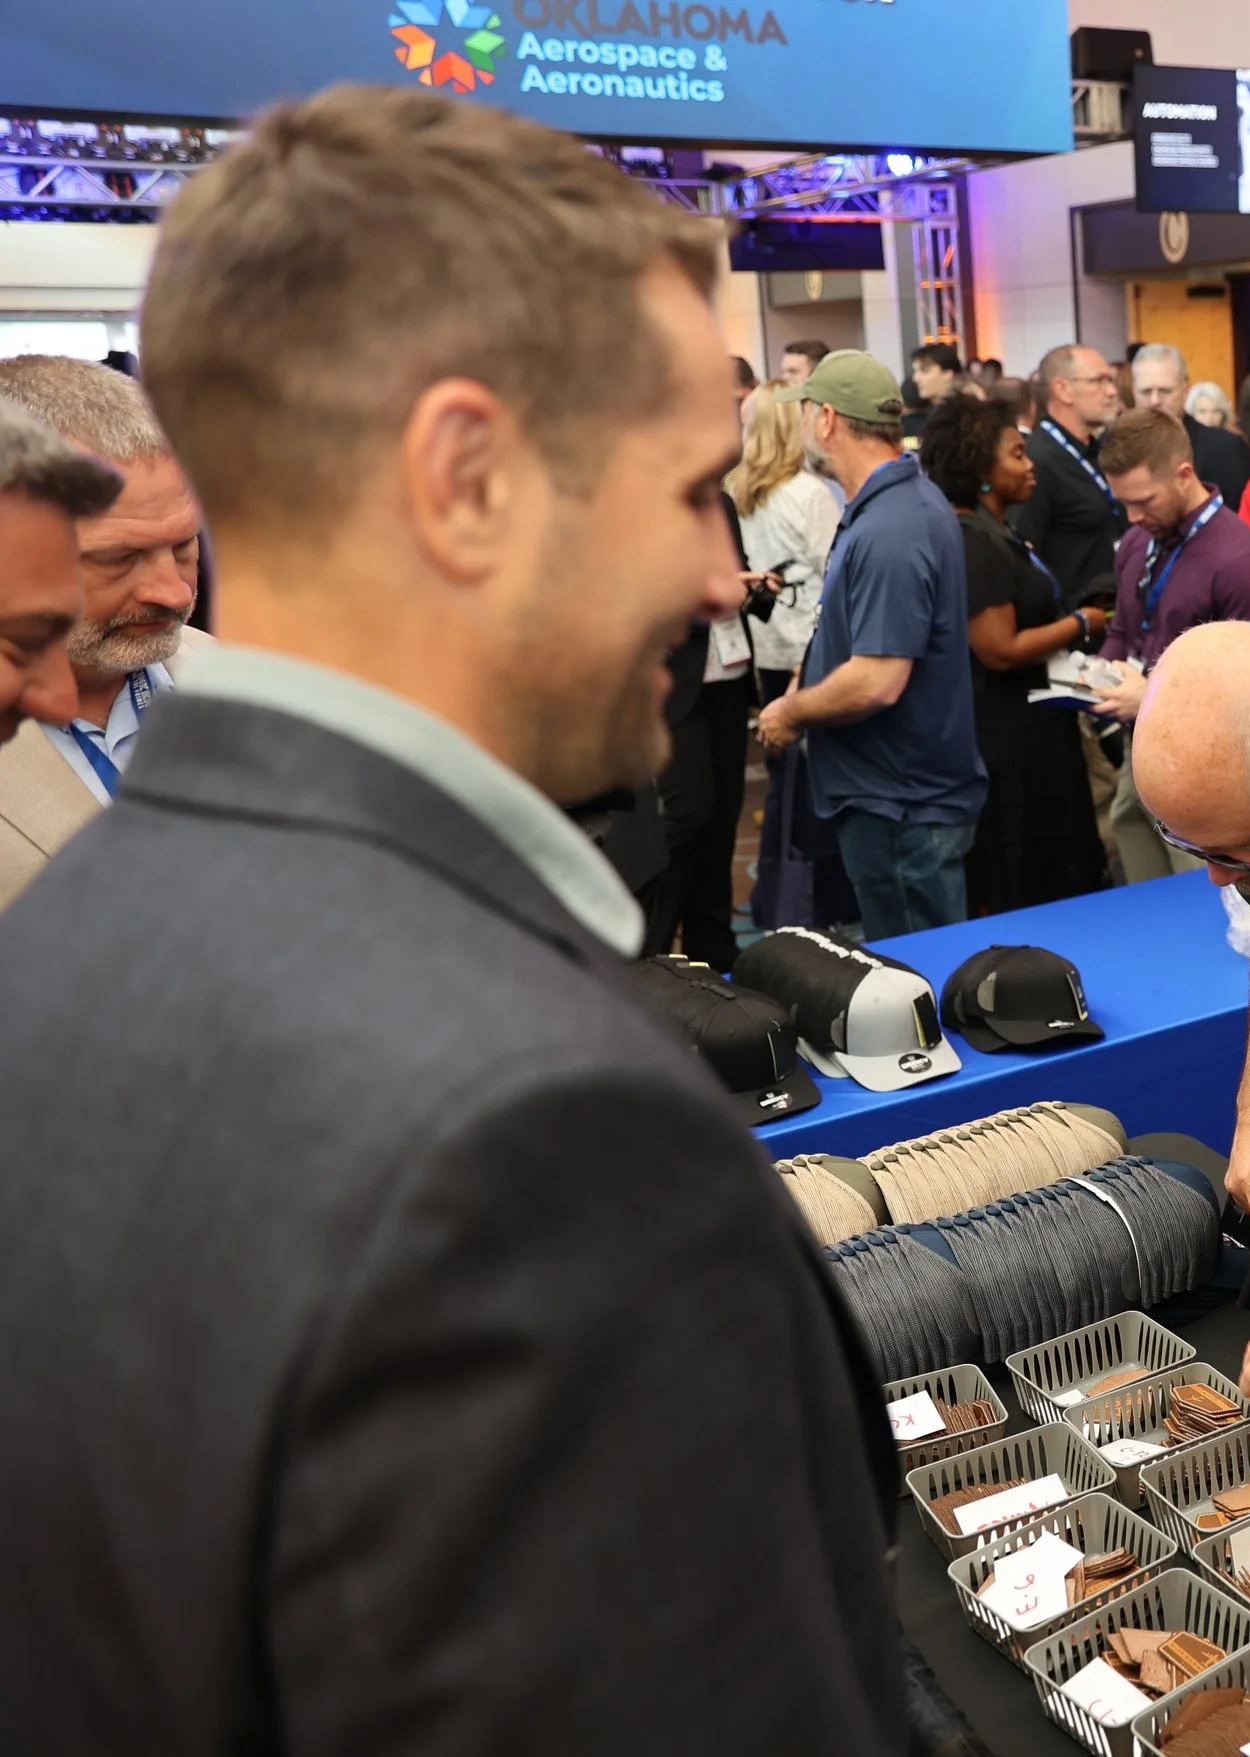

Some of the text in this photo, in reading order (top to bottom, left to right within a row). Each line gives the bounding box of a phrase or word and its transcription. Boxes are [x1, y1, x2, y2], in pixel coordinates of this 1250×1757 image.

[513, 0, 789, 46] OKLAHOMA
[516, 32, 728, 72] Aerospace &
[519, 64, 725, 102] Aeronautics
